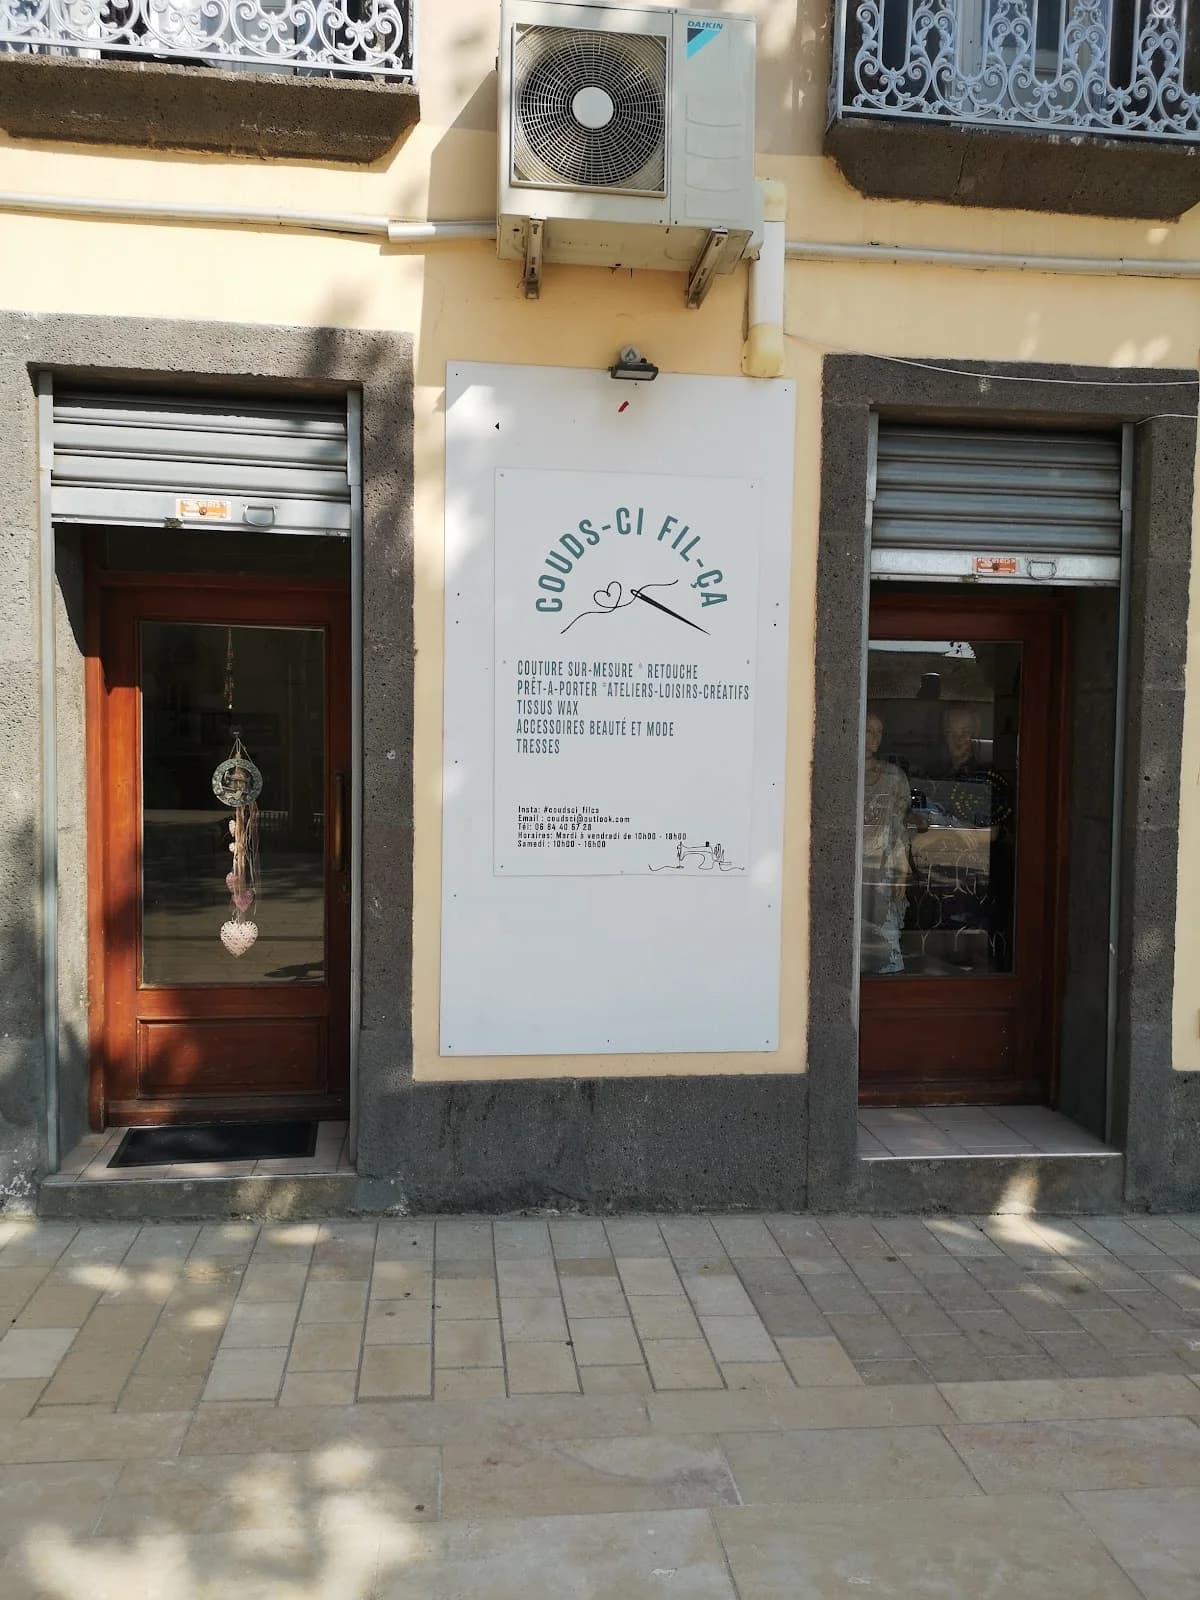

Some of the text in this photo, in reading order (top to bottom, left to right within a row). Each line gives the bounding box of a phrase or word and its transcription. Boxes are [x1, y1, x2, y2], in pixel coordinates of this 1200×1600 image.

[687, 20, 724, 30] DAIKIN
[535, 507, 728, 613] COUDS-CI FIL-ÇA
[517, 660, 698, 680] COUTURE SUR-MESURE RETOUCHE
[516, 699, 579, 716] TISSUS WAX
[516, 717, 674, 737] ACCESSOIRES BEAUTÉ ET MODE
[516, 738, 560, 754] TRESSES
[518, 805, 541, 814] Insta:
[518, 814, 539, 823] Email
[546, 814, 630, 825] coudsci@outlook.com
[518, 832, 553, 840] Horaires:
[556, 832, 577, 840] Mardi
[587, 832, 620, 841] vendredi
[623, 832, 632, 840] de
[635, 832, 656, 841] 10h00
[517, 840, 545, 848] Samedi
[553, 840, 575, 848] 10h00
